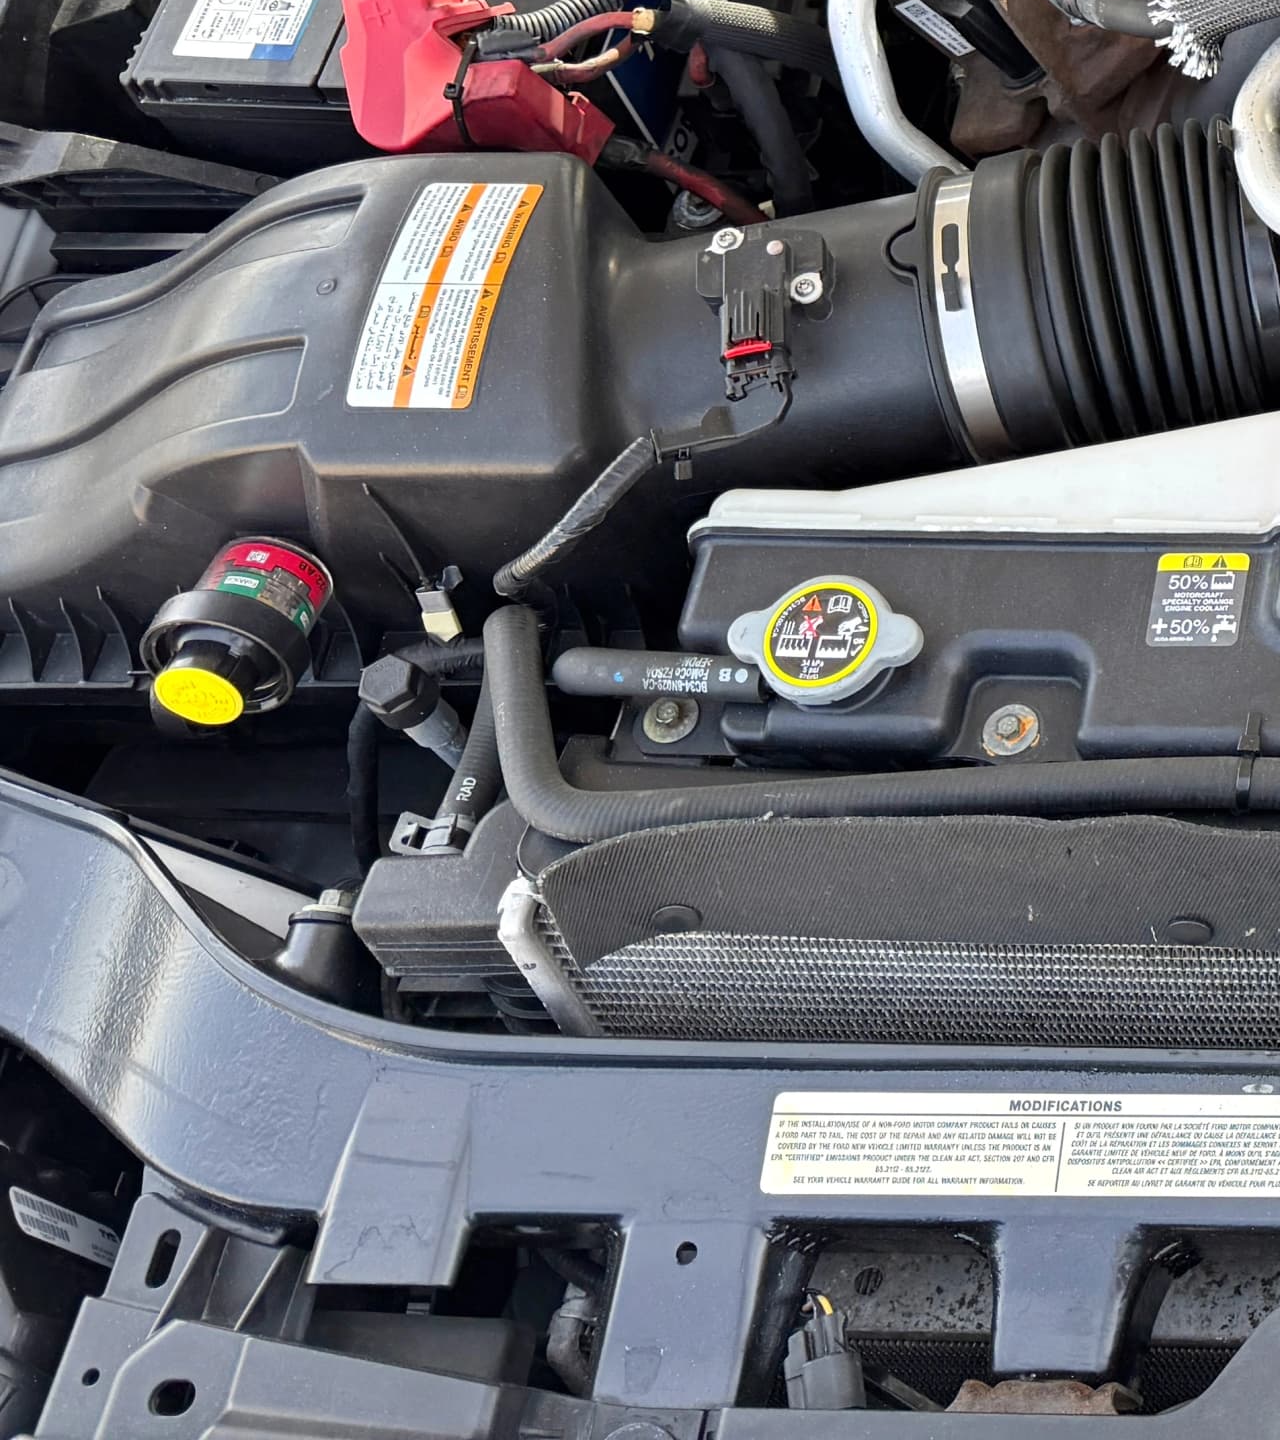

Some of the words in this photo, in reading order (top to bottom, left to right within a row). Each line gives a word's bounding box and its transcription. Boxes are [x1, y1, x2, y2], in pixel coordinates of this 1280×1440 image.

[449, 218, 465, 242] AVISO
[501, 211, 525, 248] WARNING
[462, 305, 488, 382] AVERTISSEMENT
[1168, 574, 1209, 590] 50%
[852, 637, 865, 646] OK
[718, 668, 733, 682] B
[456, 777, 477, 801] RAD
[1009, 1100, 1122, 1112] MODIFICATIONS
